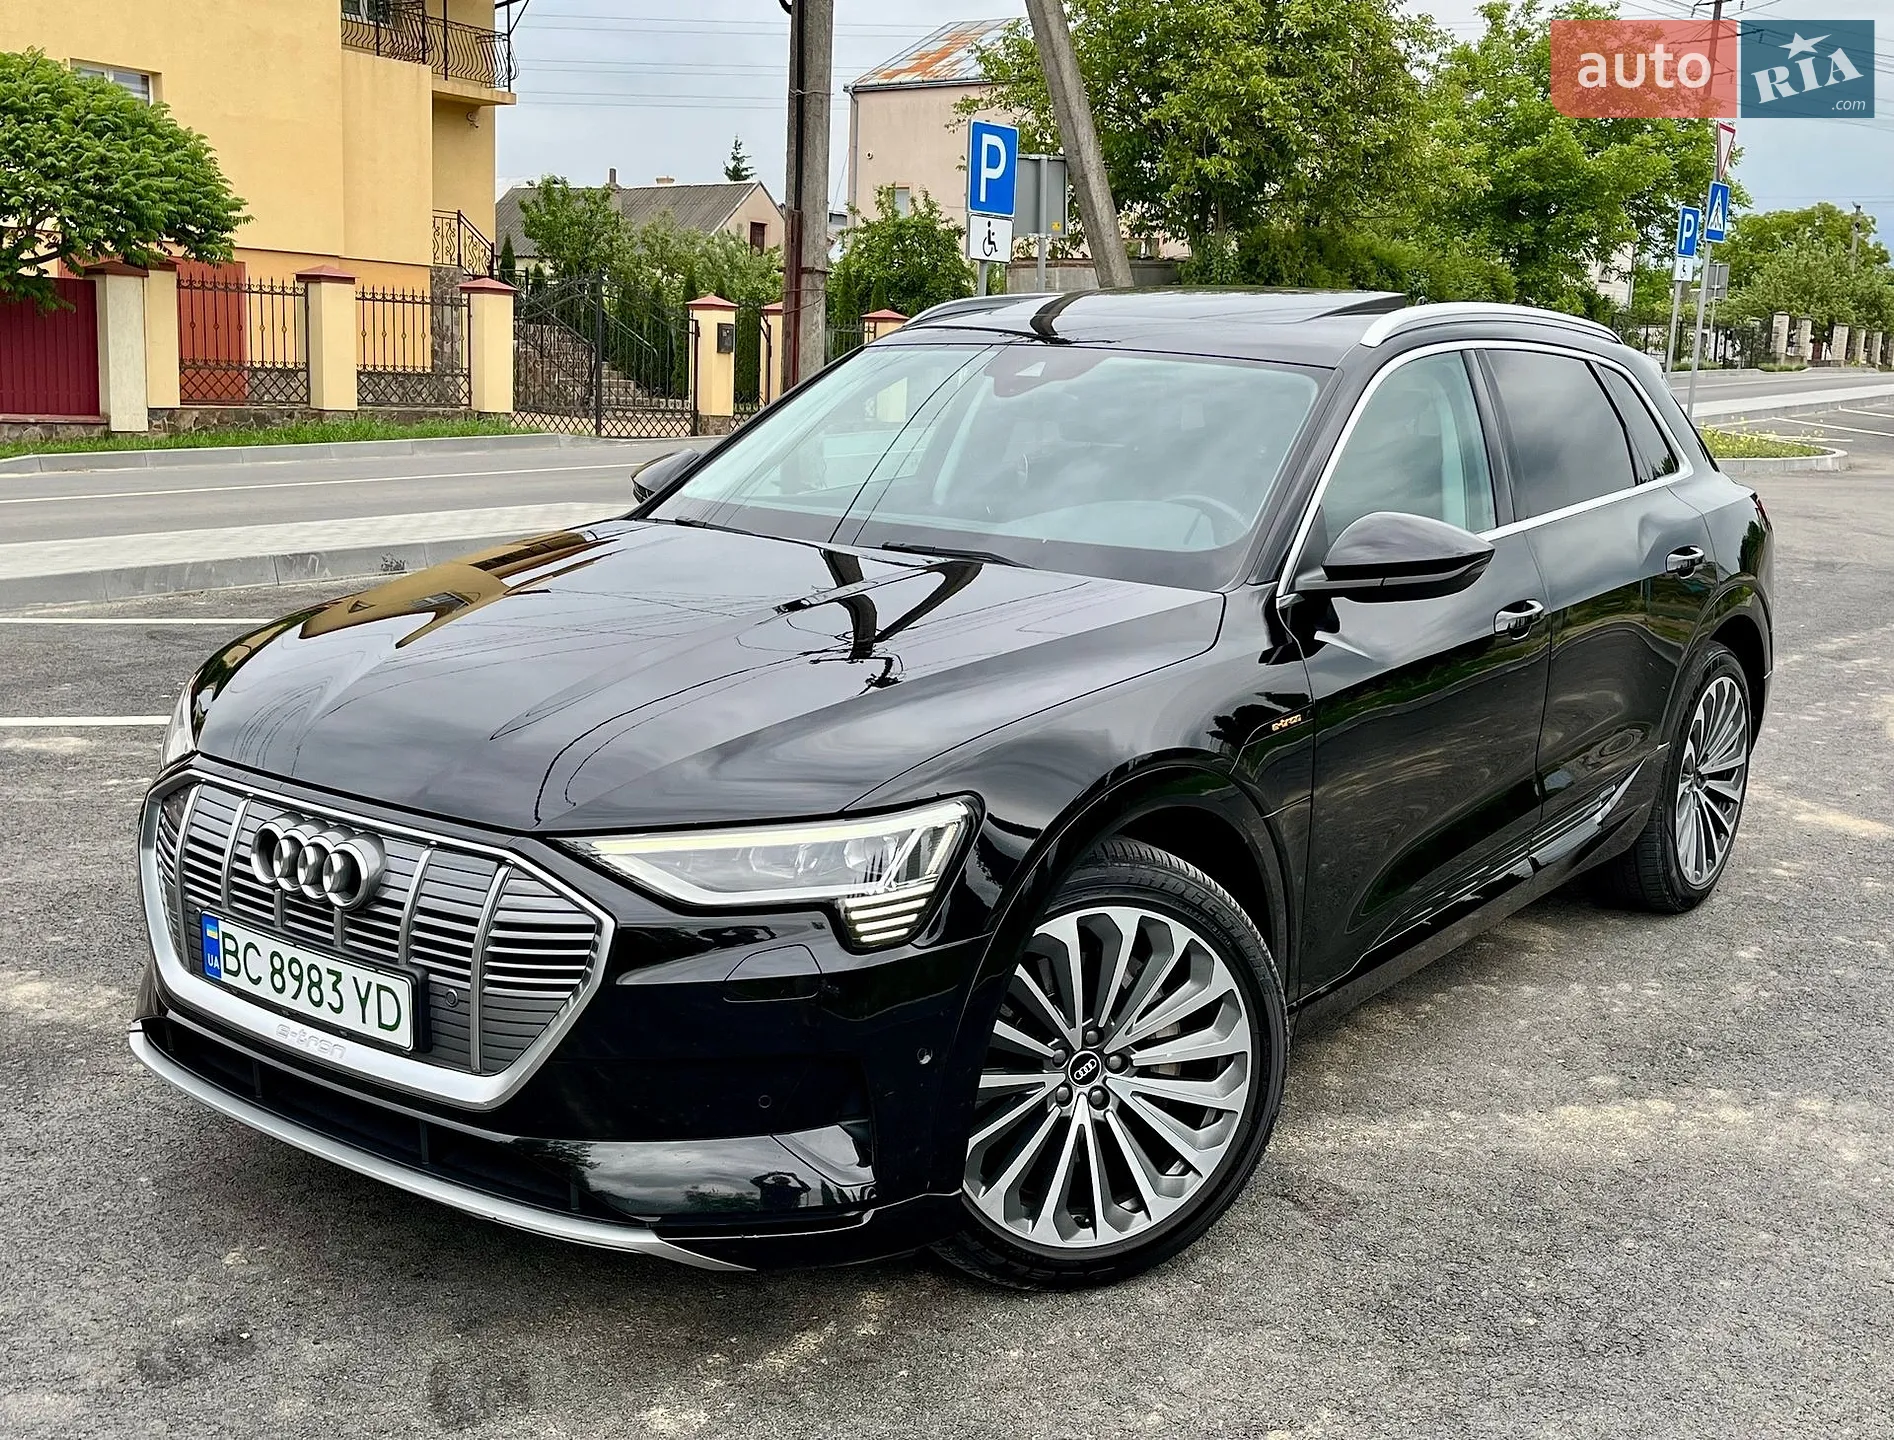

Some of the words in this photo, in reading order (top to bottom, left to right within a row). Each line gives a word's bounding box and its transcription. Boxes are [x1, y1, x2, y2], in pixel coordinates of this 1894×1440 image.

[979, 133, 1007, 203] P
[1681, 213, 1695, 251] P
[1271, 714, 1302, 732] e-tron
[207, 953, 220, 970] UA
[222, 930, 263, 986] BC
[269, 950, 344, 1014] 8983
[352, 976, 401, 1032] YD
[275, 1023, 347, 1059] e-tron
